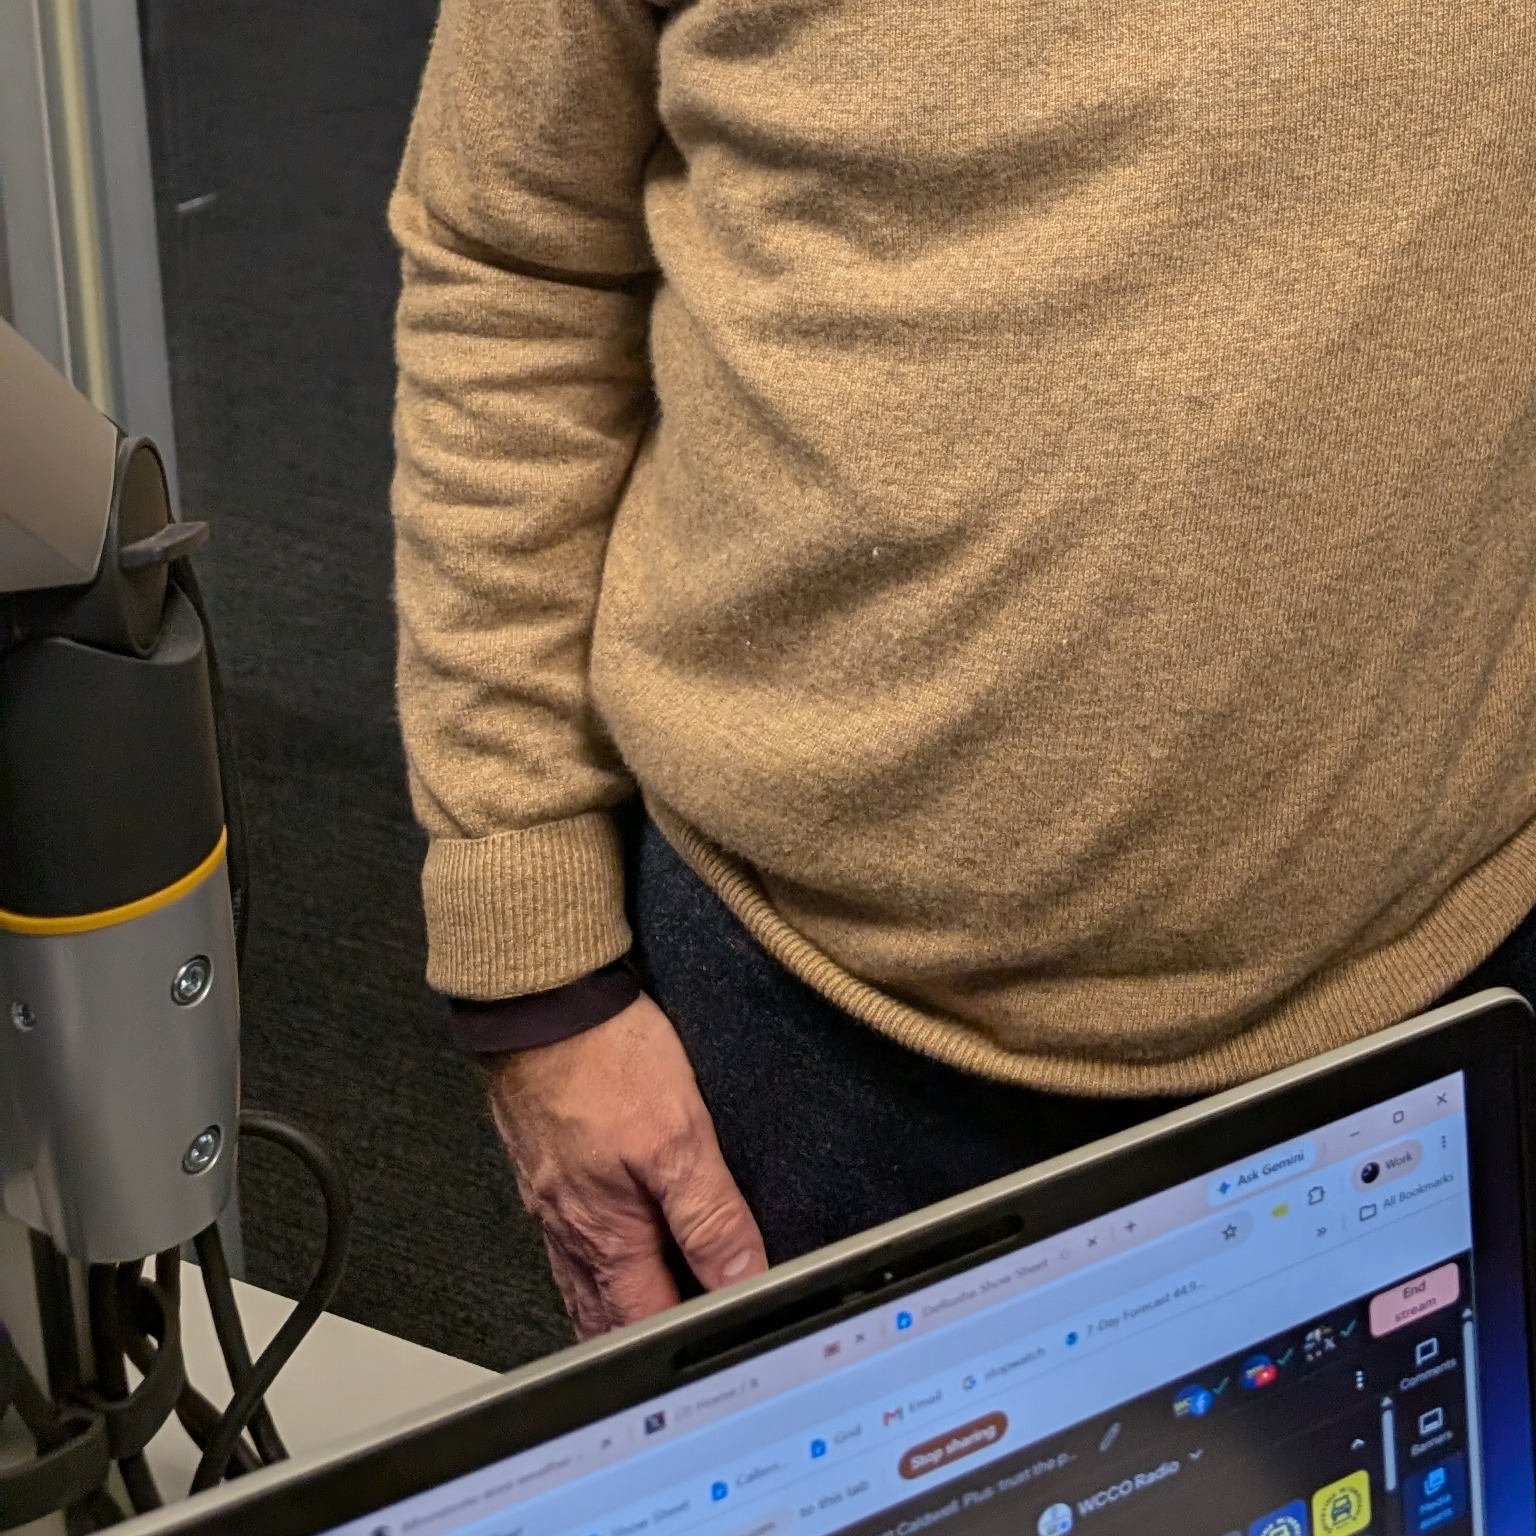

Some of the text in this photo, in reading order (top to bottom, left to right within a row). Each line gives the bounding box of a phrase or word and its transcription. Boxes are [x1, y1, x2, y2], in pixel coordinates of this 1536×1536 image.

[1237, 1151, 1305, 1186] Ask Gemini
[1385, 1151, 1413, 1169] Work
[1382, 1172, 1454, 1209] All Bookmarks
[1403, 1280, 1426, 1300] End
[1123, 1293, 1170, 1320] Forecast
[1394, 1296, 1437, 1323] stream
[984, 1347, 1046, 1381] stopwatch
[1400, 1358, 1457, 1391] Comments
[908, 1389, 943, 1413] Email
[910, 1425, 997, 1470] Stop sharing
[1410, 1430, 1454, 1457] Banners
[1077, 1461, 1180, 1515] WCCO Radio
